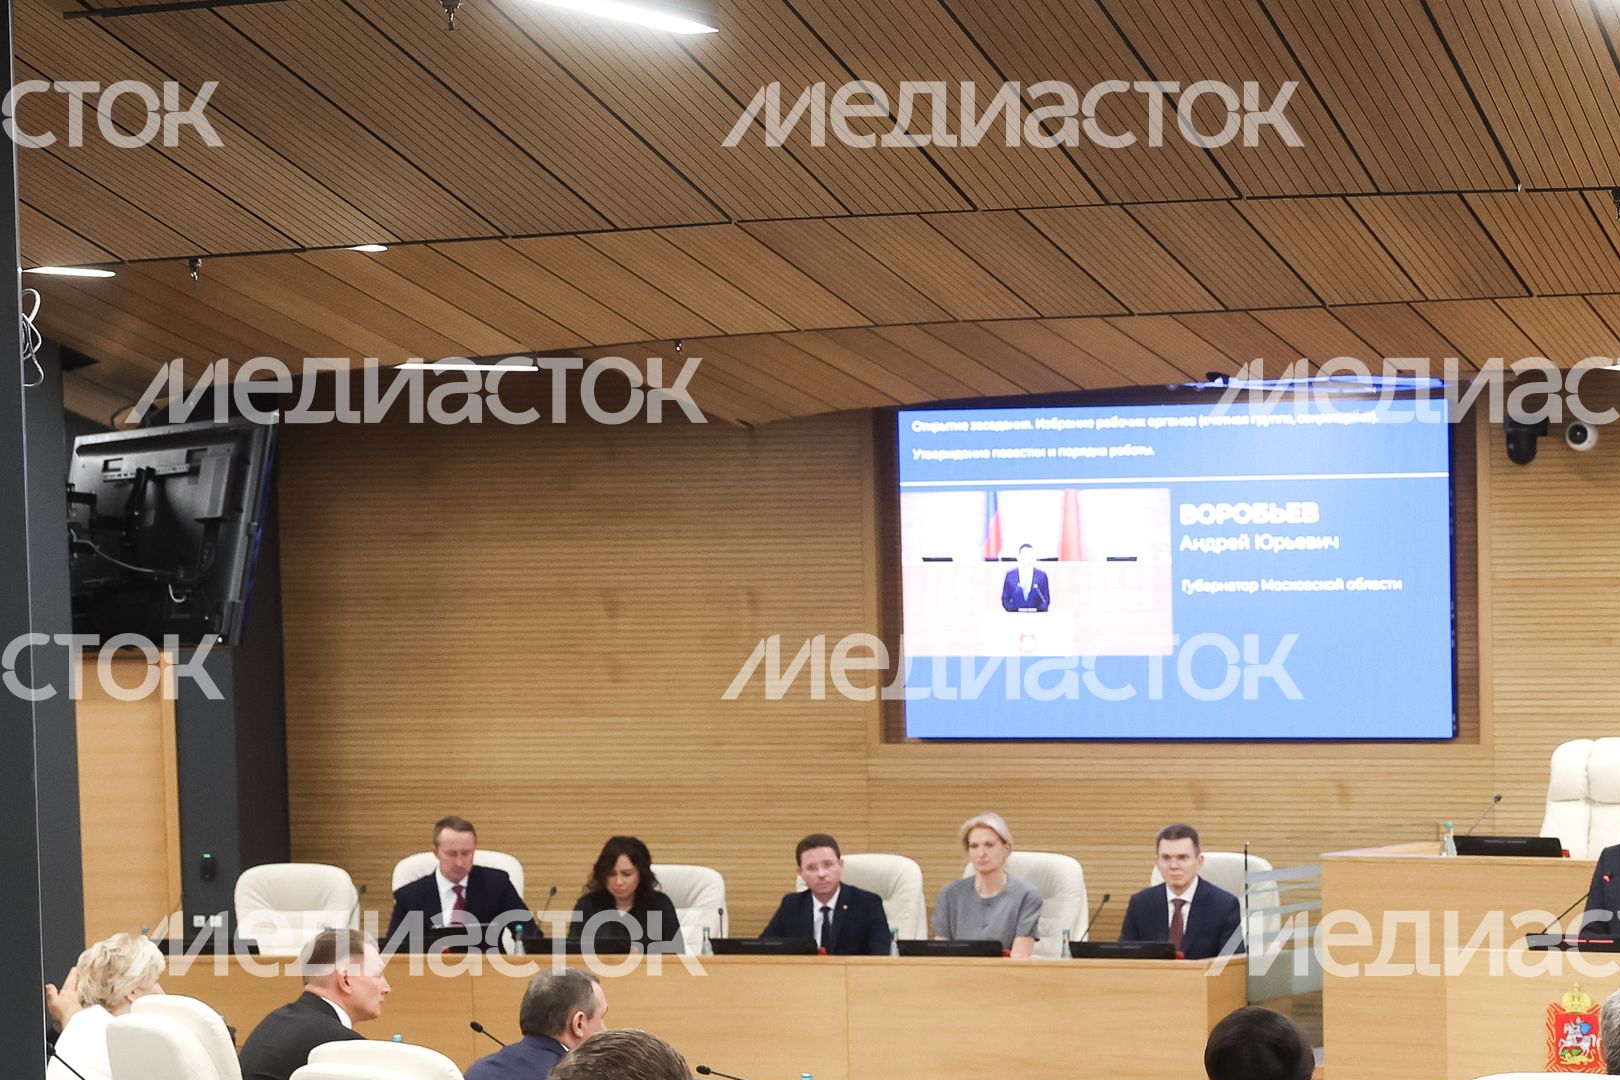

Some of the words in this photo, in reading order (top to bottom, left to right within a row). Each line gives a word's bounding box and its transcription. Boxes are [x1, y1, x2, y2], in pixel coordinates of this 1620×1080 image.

[1179, 501, 1320, 525] ВОРОБЬЕВ
[1179, 533, 1251, 554] Андрей
[1254, 533, 1340, 553] Юрьевич
[1181, 578, 1260, 595] Губернатор
[1261, 577, 1345, 592] Московской
[1346, 576, 1403, 591] области
